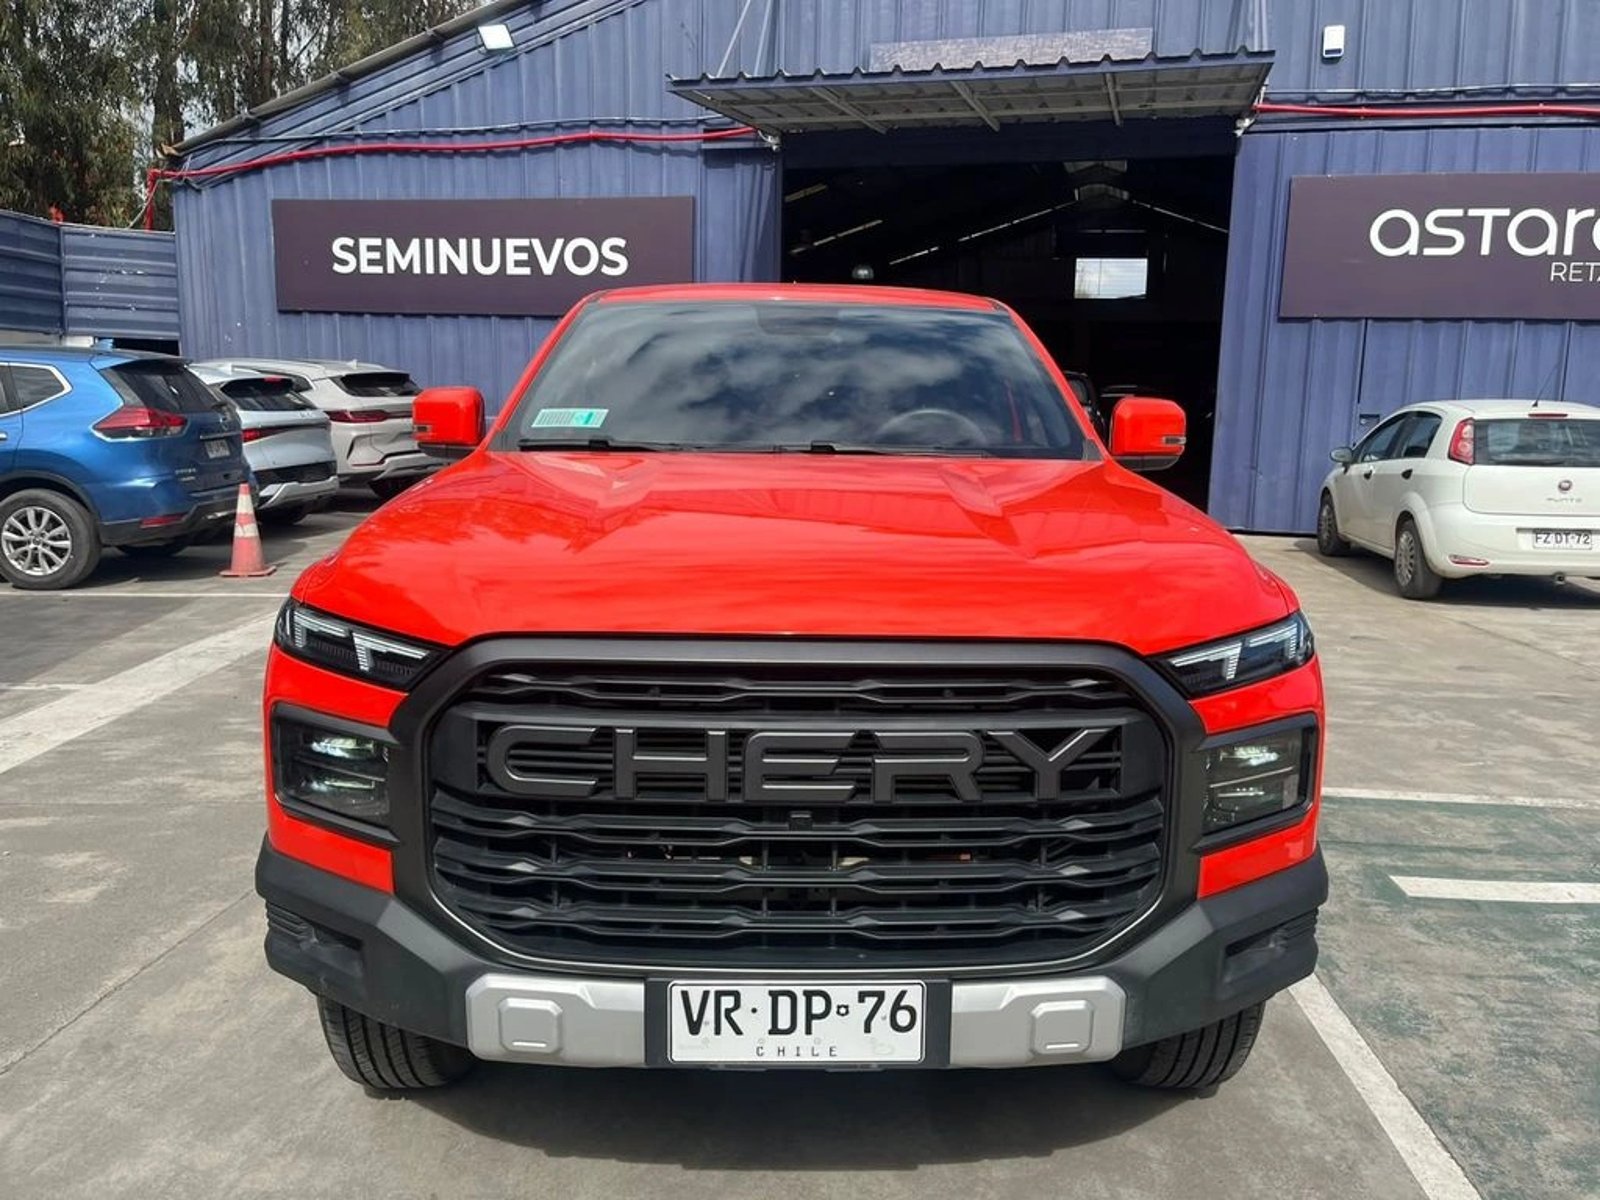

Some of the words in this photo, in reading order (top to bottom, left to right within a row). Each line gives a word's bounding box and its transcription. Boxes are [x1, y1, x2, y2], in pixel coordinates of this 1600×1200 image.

[332, 237, 628, 276] SEMINUEVOS
[1550, 262, 1600, 282] RET
[488, 727, 1112, 801] CHERY
[756, 1046, 838, 1057] CHILE
